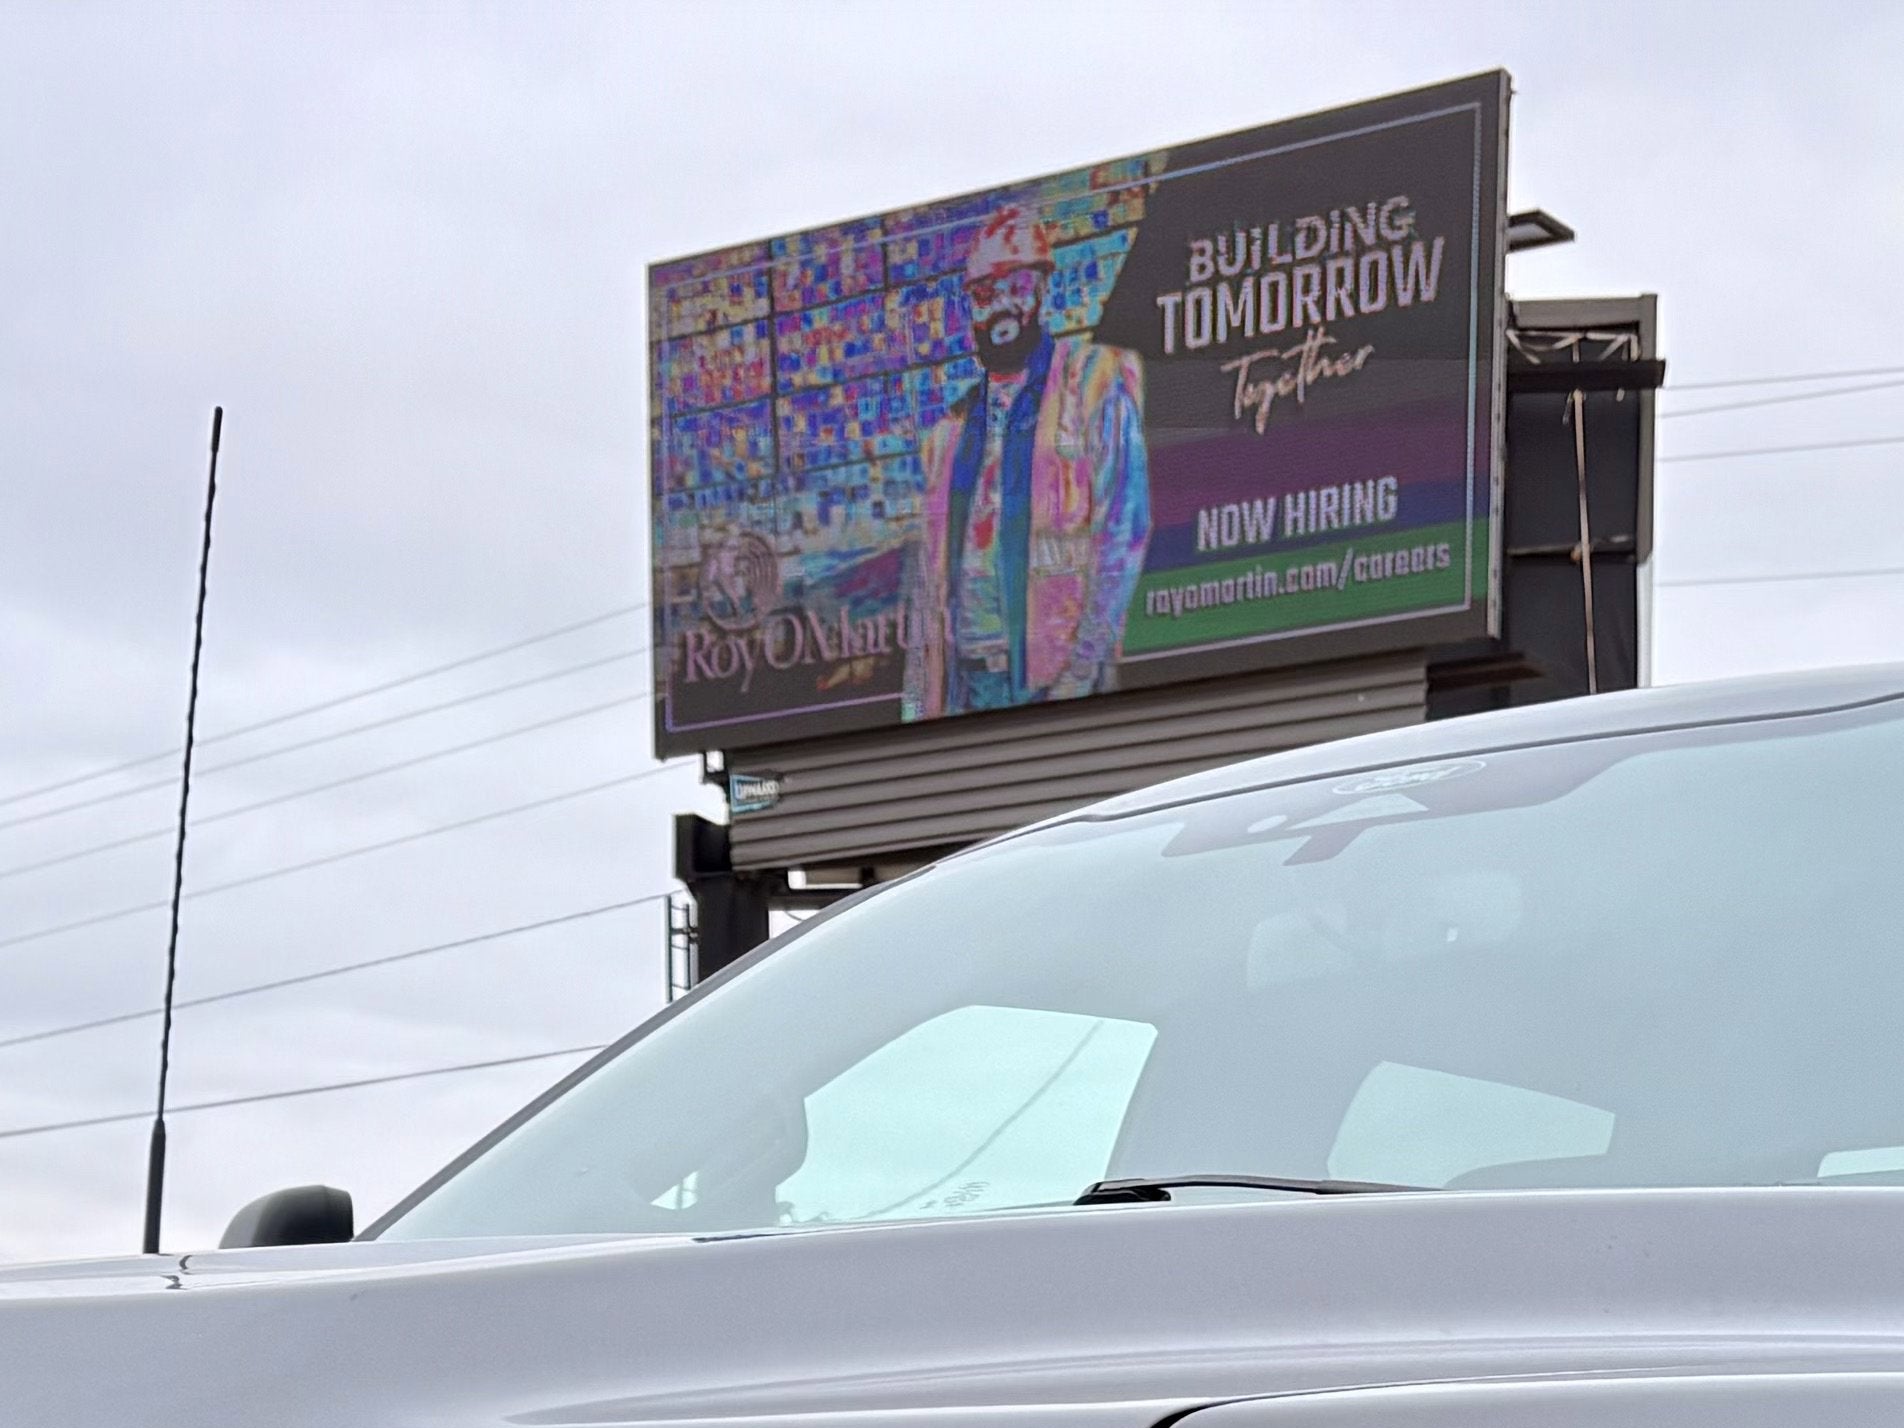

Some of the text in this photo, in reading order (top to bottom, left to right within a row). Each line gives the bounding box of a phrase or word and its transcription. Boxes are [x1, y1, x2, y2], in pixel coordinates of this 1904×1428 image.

[1186, 195, 1416, 286] BUILDING
[1156, 236, 1445, 354] TOMORROW
[1221, 325, 1375, 435] Together
[1197, 475, 1399, 552] NOW HIRING
[1145, 541, 1450, 618] royomartin.com/careers
